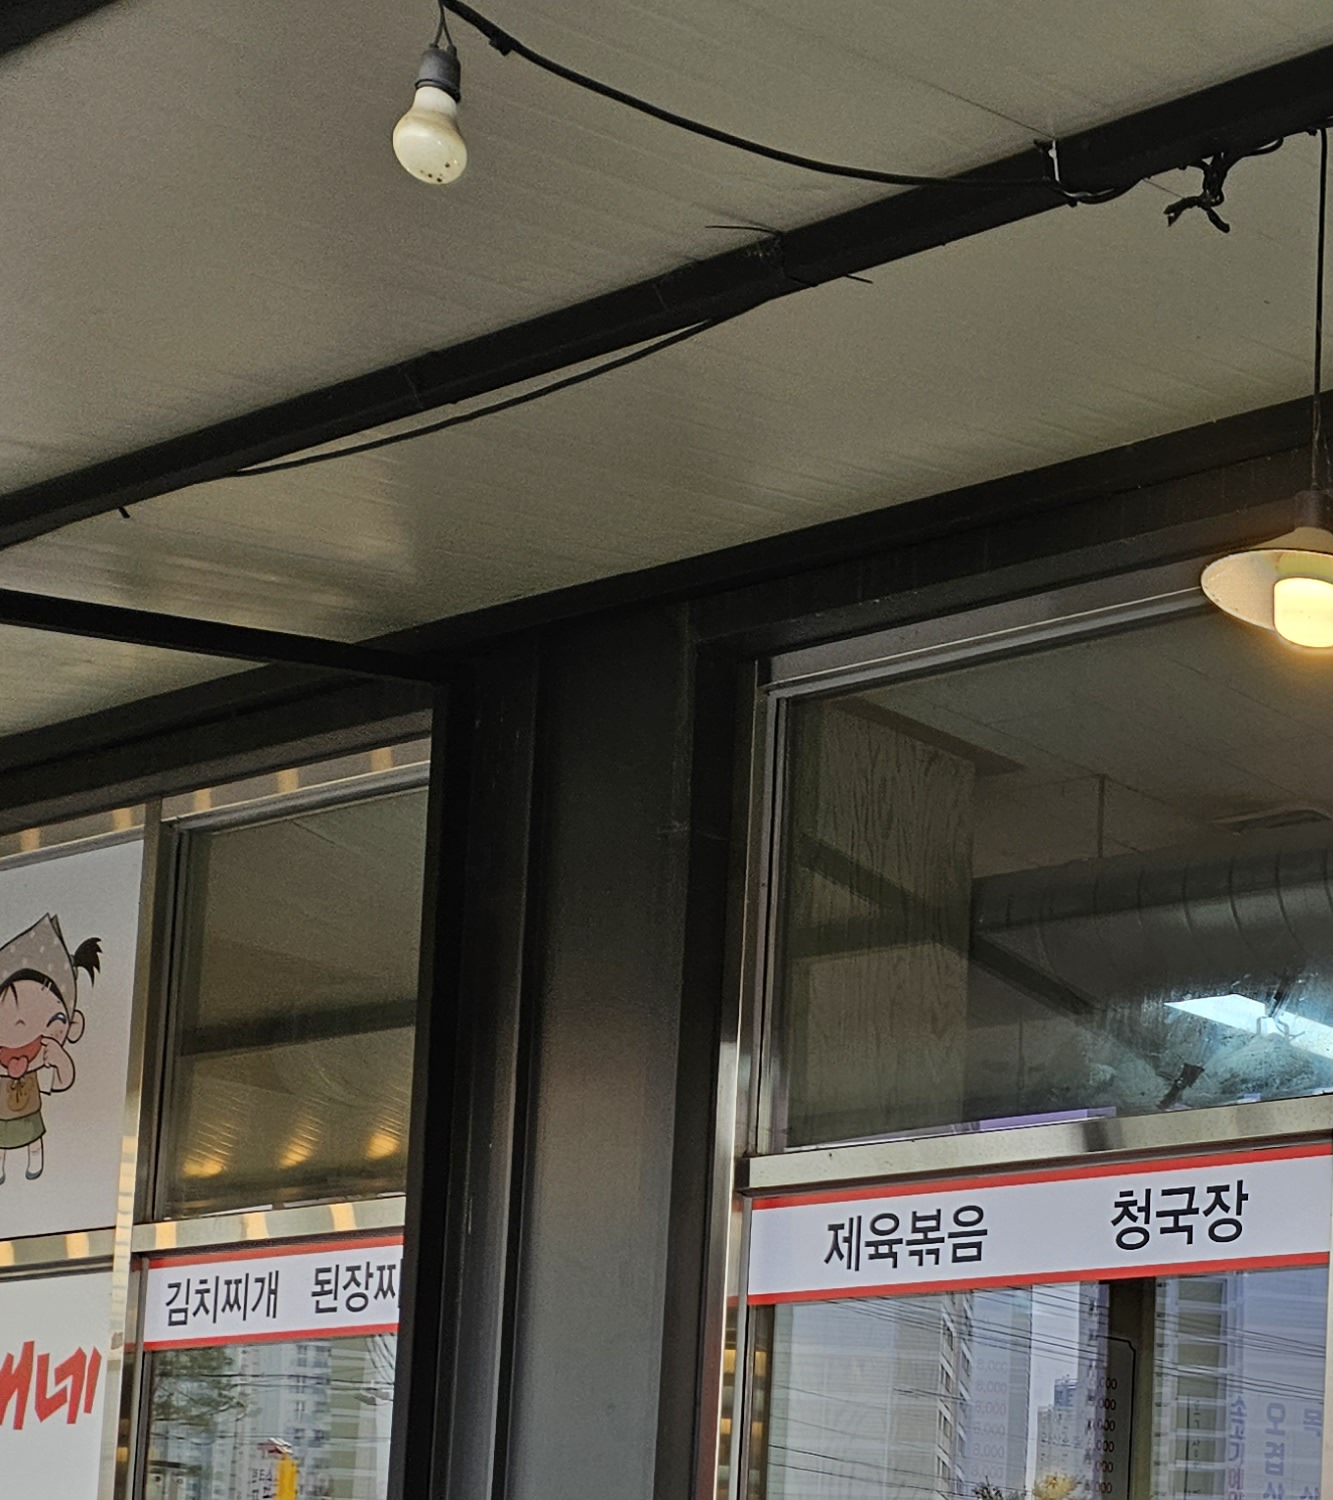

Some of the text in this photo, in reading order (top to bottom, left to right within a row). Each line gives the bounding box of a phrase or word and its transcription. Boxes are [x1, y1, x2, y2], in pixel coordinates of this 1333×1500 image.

[823, 1179, 1249, 1272] 제육볶음 청국장
[165, 1270, 280, 1327] 김치찌개
